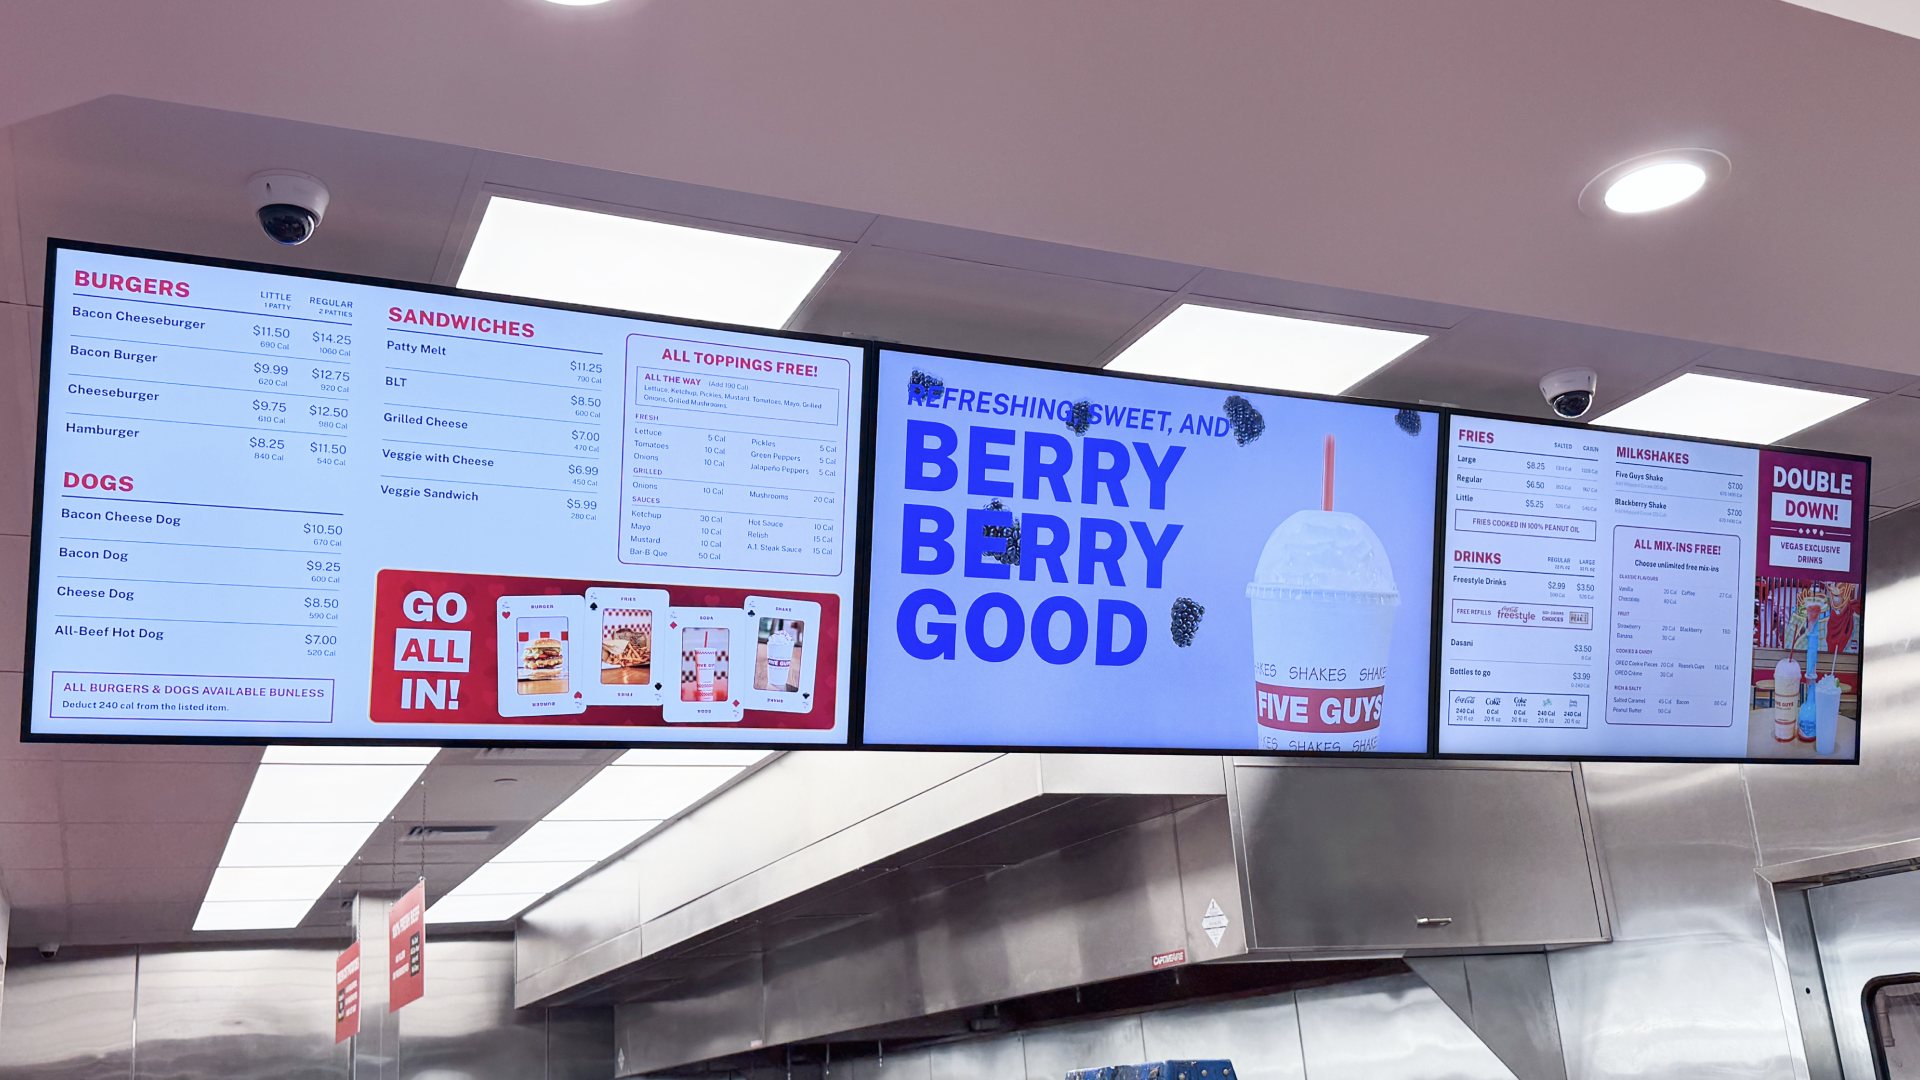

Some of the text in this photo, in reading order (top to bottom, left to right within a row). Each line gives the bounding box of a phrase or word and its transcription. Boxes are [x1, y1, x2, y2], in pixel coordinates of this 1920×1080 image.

[74, 270, 191, 298] BURGERS
[260, 291, 354, 308] LITTLE REGULAR
[72, 307, 206, 329] Bacon Cheeseburger
[324, 309, 353, 317] PATTIES
[388, 307, 535, 338] SANDWICHES
[252, 325, 291, 338] $11.50
[312, 331, 352, 345] $14.25
[70, 345, 158, 363] Bacon Burger
[386, 341, 446, 355] Patty Melt
[253, 362, 289, 375] $9.99
[569, 360, 603, 373] $11.25
[661, 349, 818, 377] ALL TOPPINGS FREE!
[311, 368, 350, 381] $12.75
[662, 375, 681, 383] THE
[385, 377, 408, 386] BLT
[67, 384, 160, 401] Cheeseburger
[252, 399, 287, 412] $9.75
[570, 395, 602, 407] $8.50
[308, 405, 349, 418] $12.50
[907, 383, 1230, 438] REFRESHING, SWEET, AND
[383, 413, 468, 429] Grilled Cheese
[65, 423, 140, 438] Hamburger
[571, 430, 600, 441] $7.00
[634, 428, 663, 436] Lettuce
[1458, 429, 1495, 443] FRIES
[249, 437, 285, 449] $8.25
[309, 442, 347, 454] $11.50
[633, 440, 670, 449] Tomatoes
[751, 439, 776, 447] Pickles
[381, 449, 494, 466] Veggie with Cheese
[1457, 455, 1477, 464] Large
[1616, 446, 1690, 464] MILKSHAKES
[568, 464, 599, 475] $6.99
[904, 419, 1187, 510] BERRY
[1526, 461, 1546, 470] $8.25
[63, 472, 134, 492] DOGS
[1456, 474, 1483, 483] Regular
[1628, 472, 1645, 480] Guys
[1644, 474, 1664, 482] Shake
[1773, 465, 1853, 495] DOUBLE
[1526, 480, 1545, 489] $6.50
[1727, 482, 1744, 490] $7.00
[380, 485, 479, 501] Veggie Sandwich
[749, 491, 789, 500] Mushrooms
[566, 498, 598, 510] $5.99
[1525, 499, 1545, 508] $5.25
[1614, 498, 1648, 509] Blackberry
[61, 508, 181, 526] Bacon Cheese Dog
[631, 510, 662, 519] Ketchup
[1726, 508, 1743, 516] $7.00
[1785, 500, 1839, 521] DOWN!
[303, 523, 343, 535] $10.50
[630, 523, 651, 531] Mayo
[1491, 520, 1519, 528] COOKED
[900, 503, 1184, 589] BERRY
[1633, 539, 1722, 555] ALL MIX-INS FREE!
[1780, 542, 1841, 554] VEGAS EXCLUSIVE
[59, 548, 129, 562] Bacon Dog
[1453, 550, 1502, 564] DRINKS
[1797, 555, 1823, 564] DRINKS
[306, 560, 341, 571] $9.25
[1452, 575, 1485, 585] Freestyle
[1547, 581, 1566, 589] $2.99
[1576, 583, 1595, 591] $3.50
[56, 587, 135, 601] Cheese Dog
[303, 597, 339, 608] $8.50
[402, 590, 468, 624] GO
[1497, 609, 1536, 623] freestyle
[54, 626, 164, 640] All-Beef Hot Dog
[896, 588, 1148, 666] GOOD
[304, 634, 337, 644] $7.00
[401, 637, 464, 664] ALL
[1573, 644, 1593, 652] $3.50
[1289, 667, 1347, 682] SHAKES
[1572, 672, 1591, 680] $3.99
[63, 683, 325, 697] ALL BURGERS & DOGS AVAILABLE BUNLESS
[401, 678, 460, 711] IN!
[1258, 690, 1382, 725] FIVE GUYS
